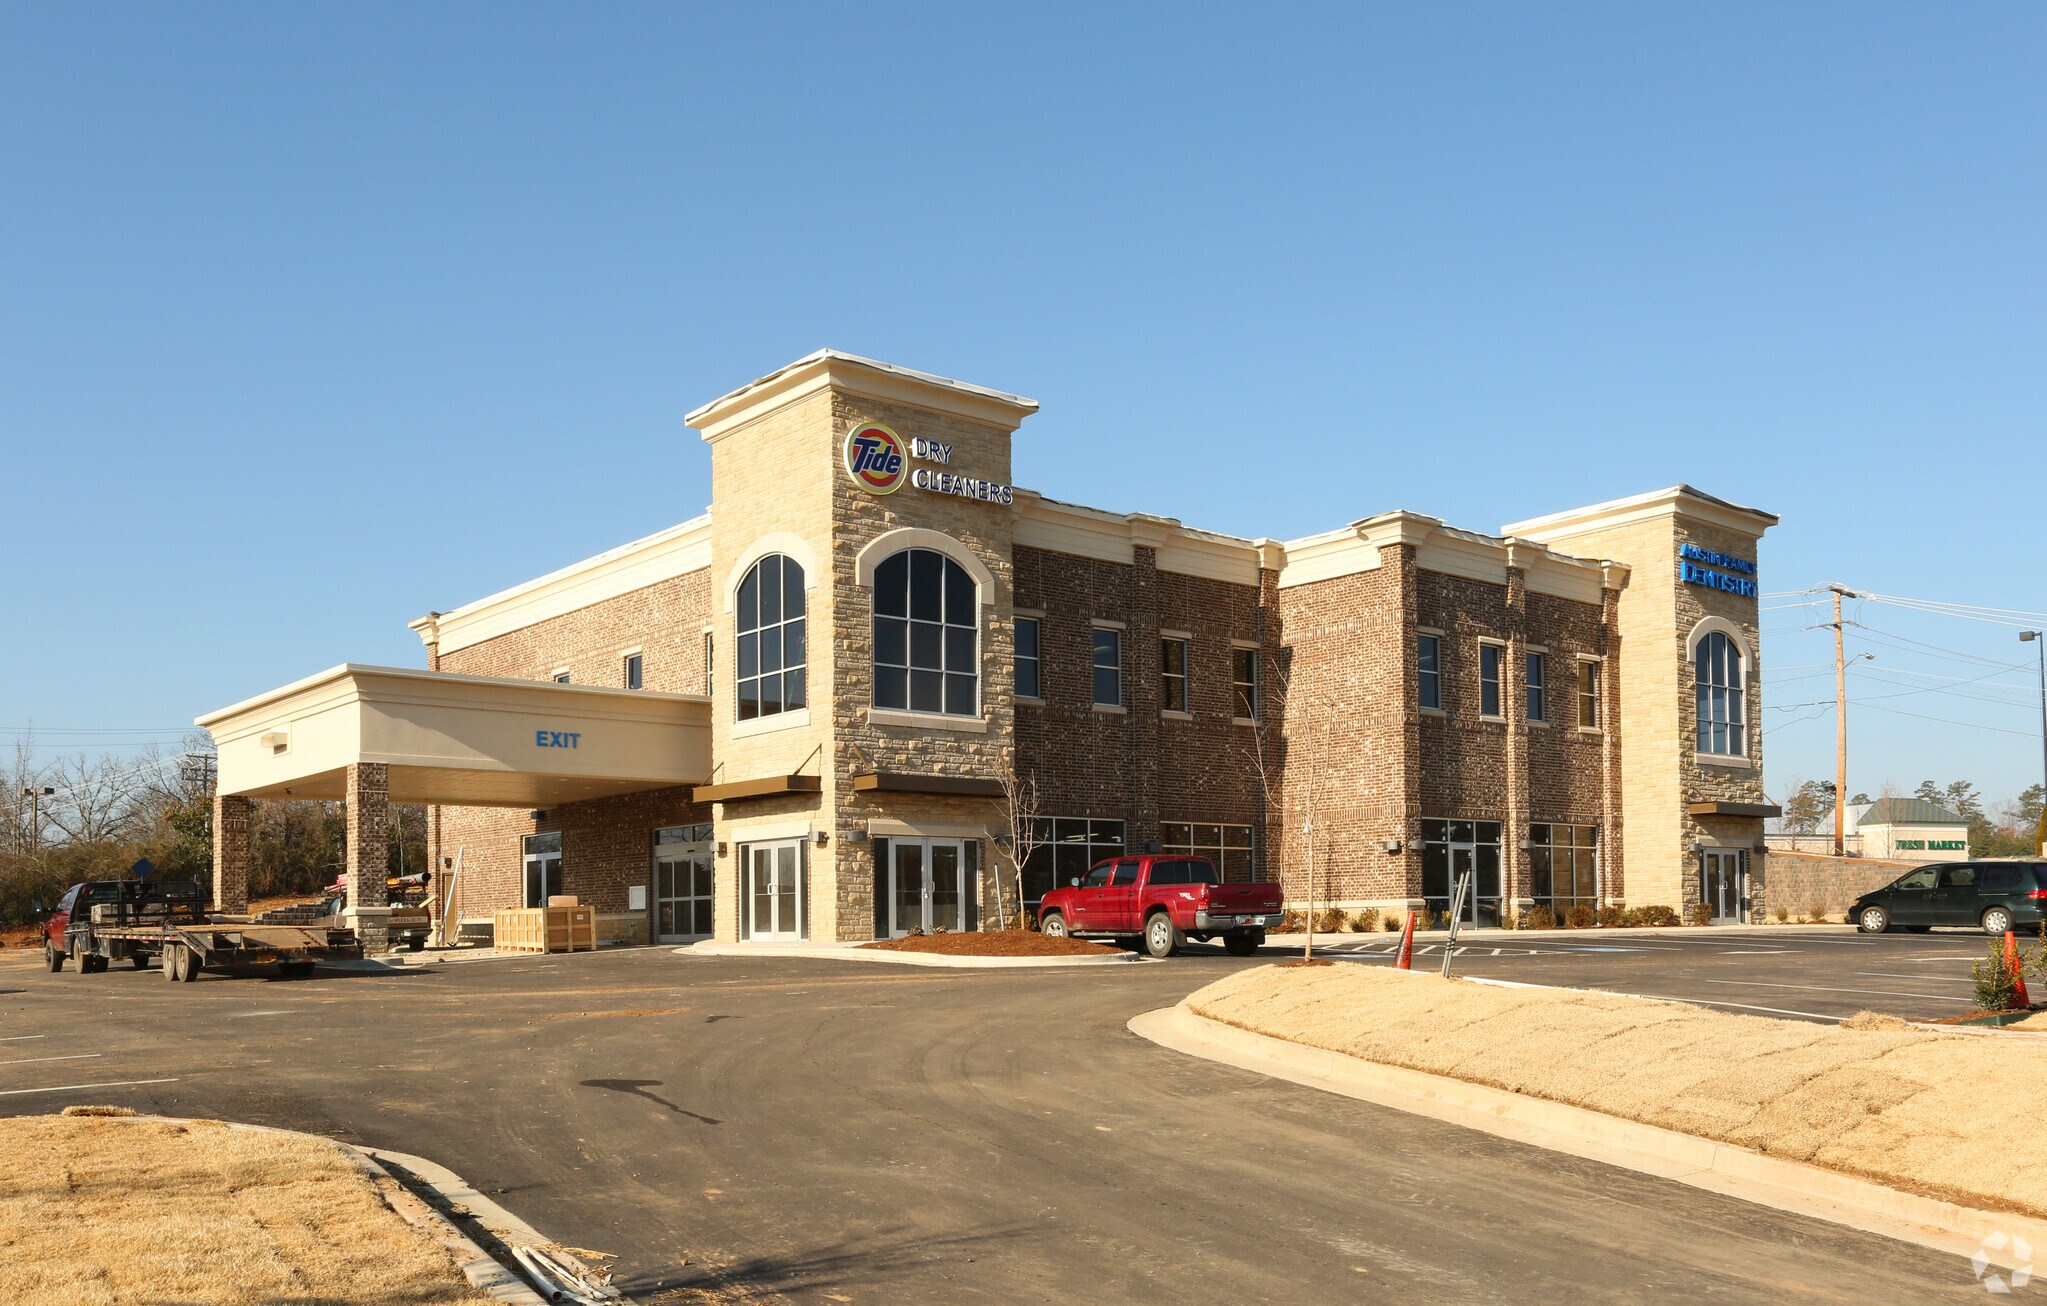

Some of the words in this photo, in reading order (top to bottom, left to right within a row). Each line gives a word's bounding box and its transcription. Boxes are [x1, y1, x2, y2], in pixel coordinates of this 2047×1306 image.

[852, 438, 901, 473] Tide
[913, 437, 952, 463] DRY
[913, 469, 1013, 505] CLEANERS
[1681, 562, 1758, 597] DENTISTRY
[536, 731, 581, 748] EXIT
[1928, 840, 1966, 850] MARKET
